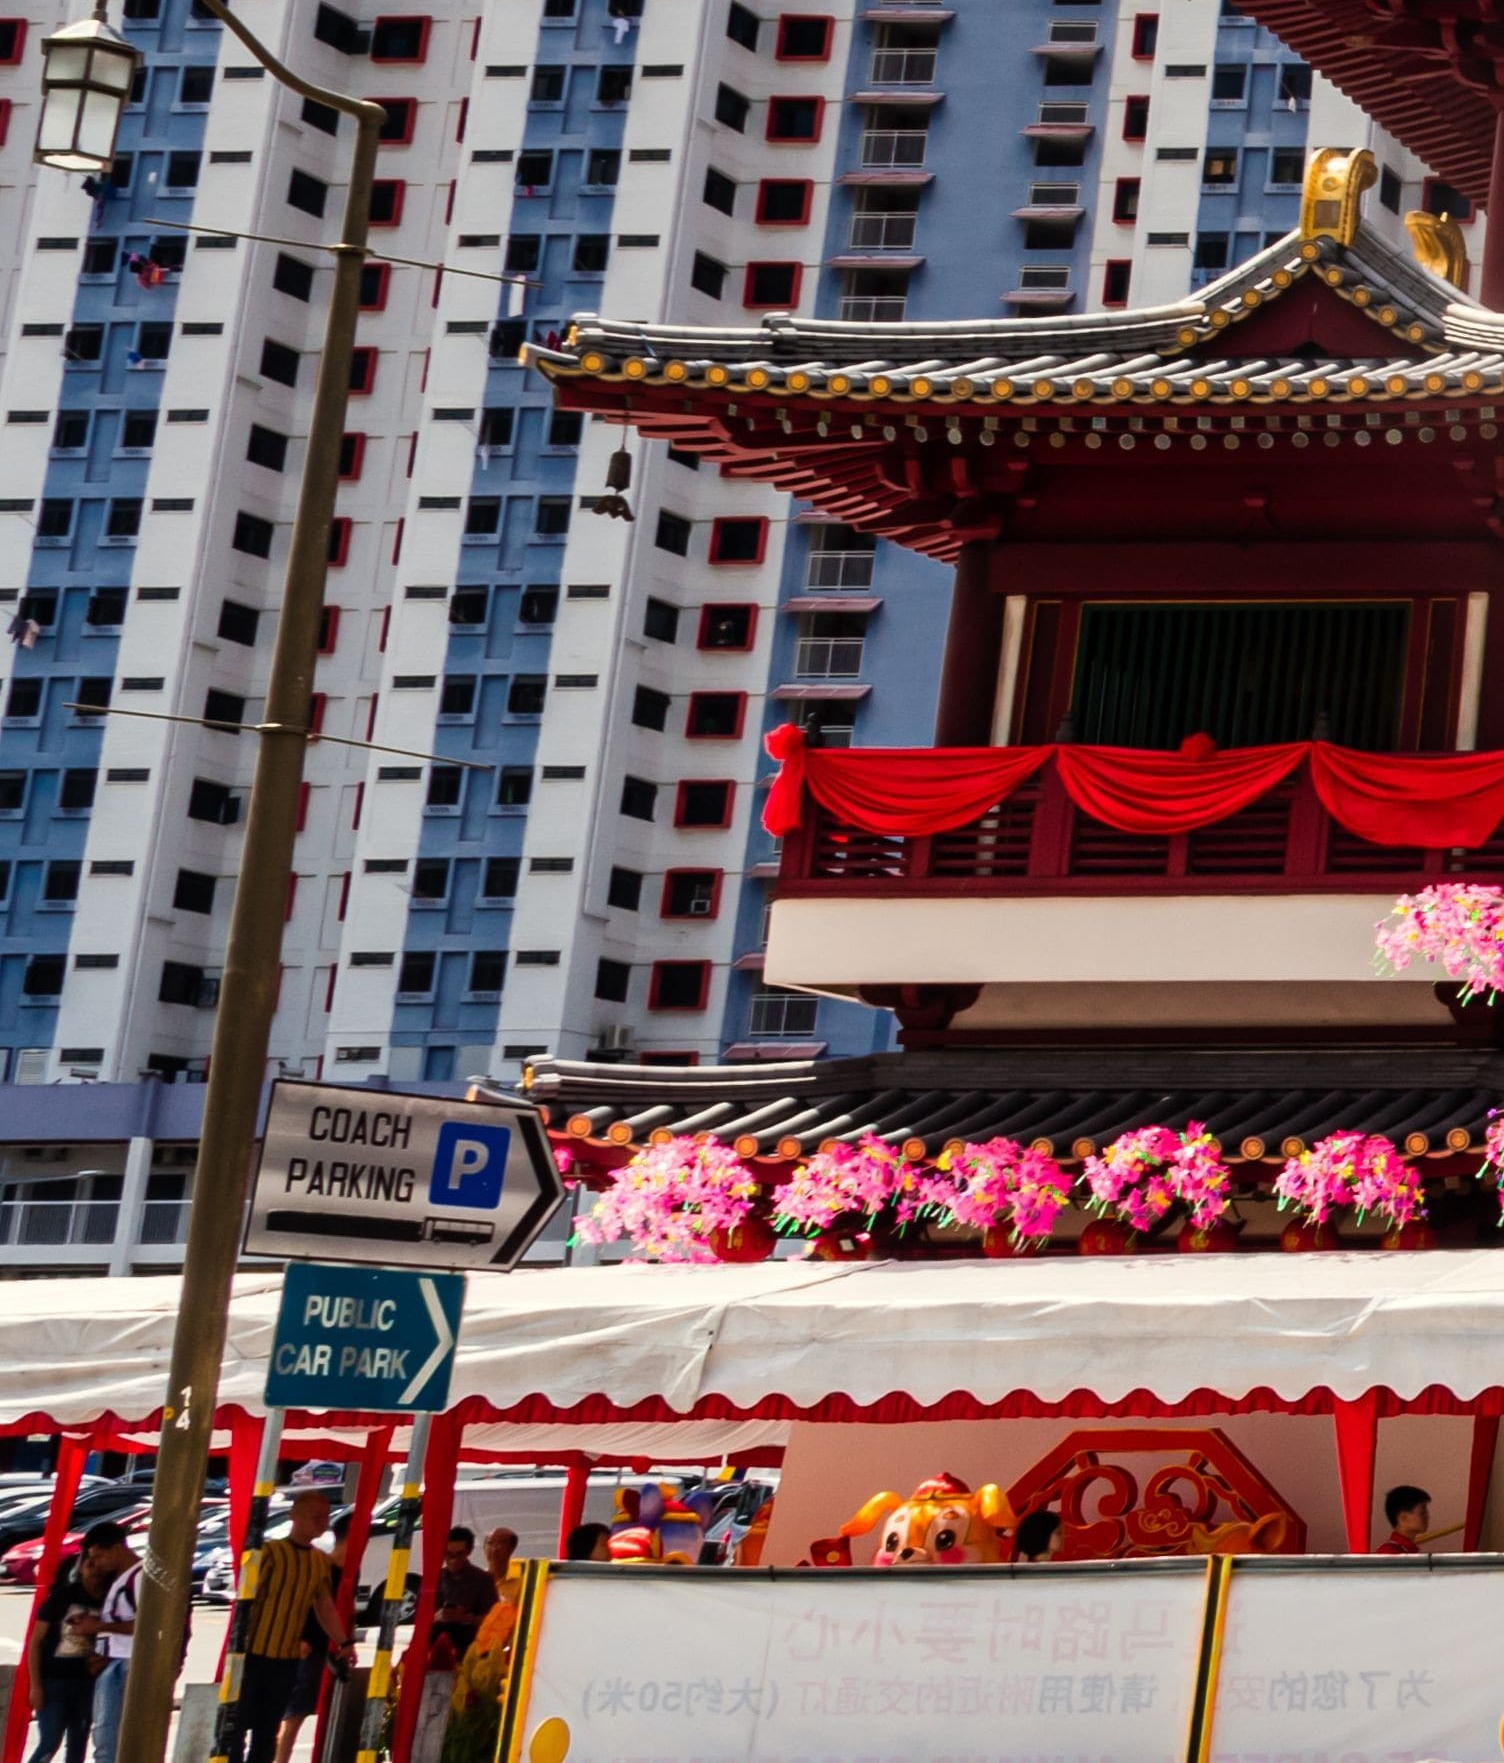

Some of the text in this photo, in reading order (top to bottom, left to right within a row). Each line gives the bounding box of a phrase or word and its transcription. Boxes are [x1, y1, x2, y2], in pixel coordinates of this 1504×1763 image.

[308, 1106, 412, 1150] COACH
[285, 1157, 416, 1203] PARKING
[447, 1139, 490, 1189] P
[303, 1294, 397, 1331] PUBLIC
[274, 1343, 411, 1380] CAR PARK
